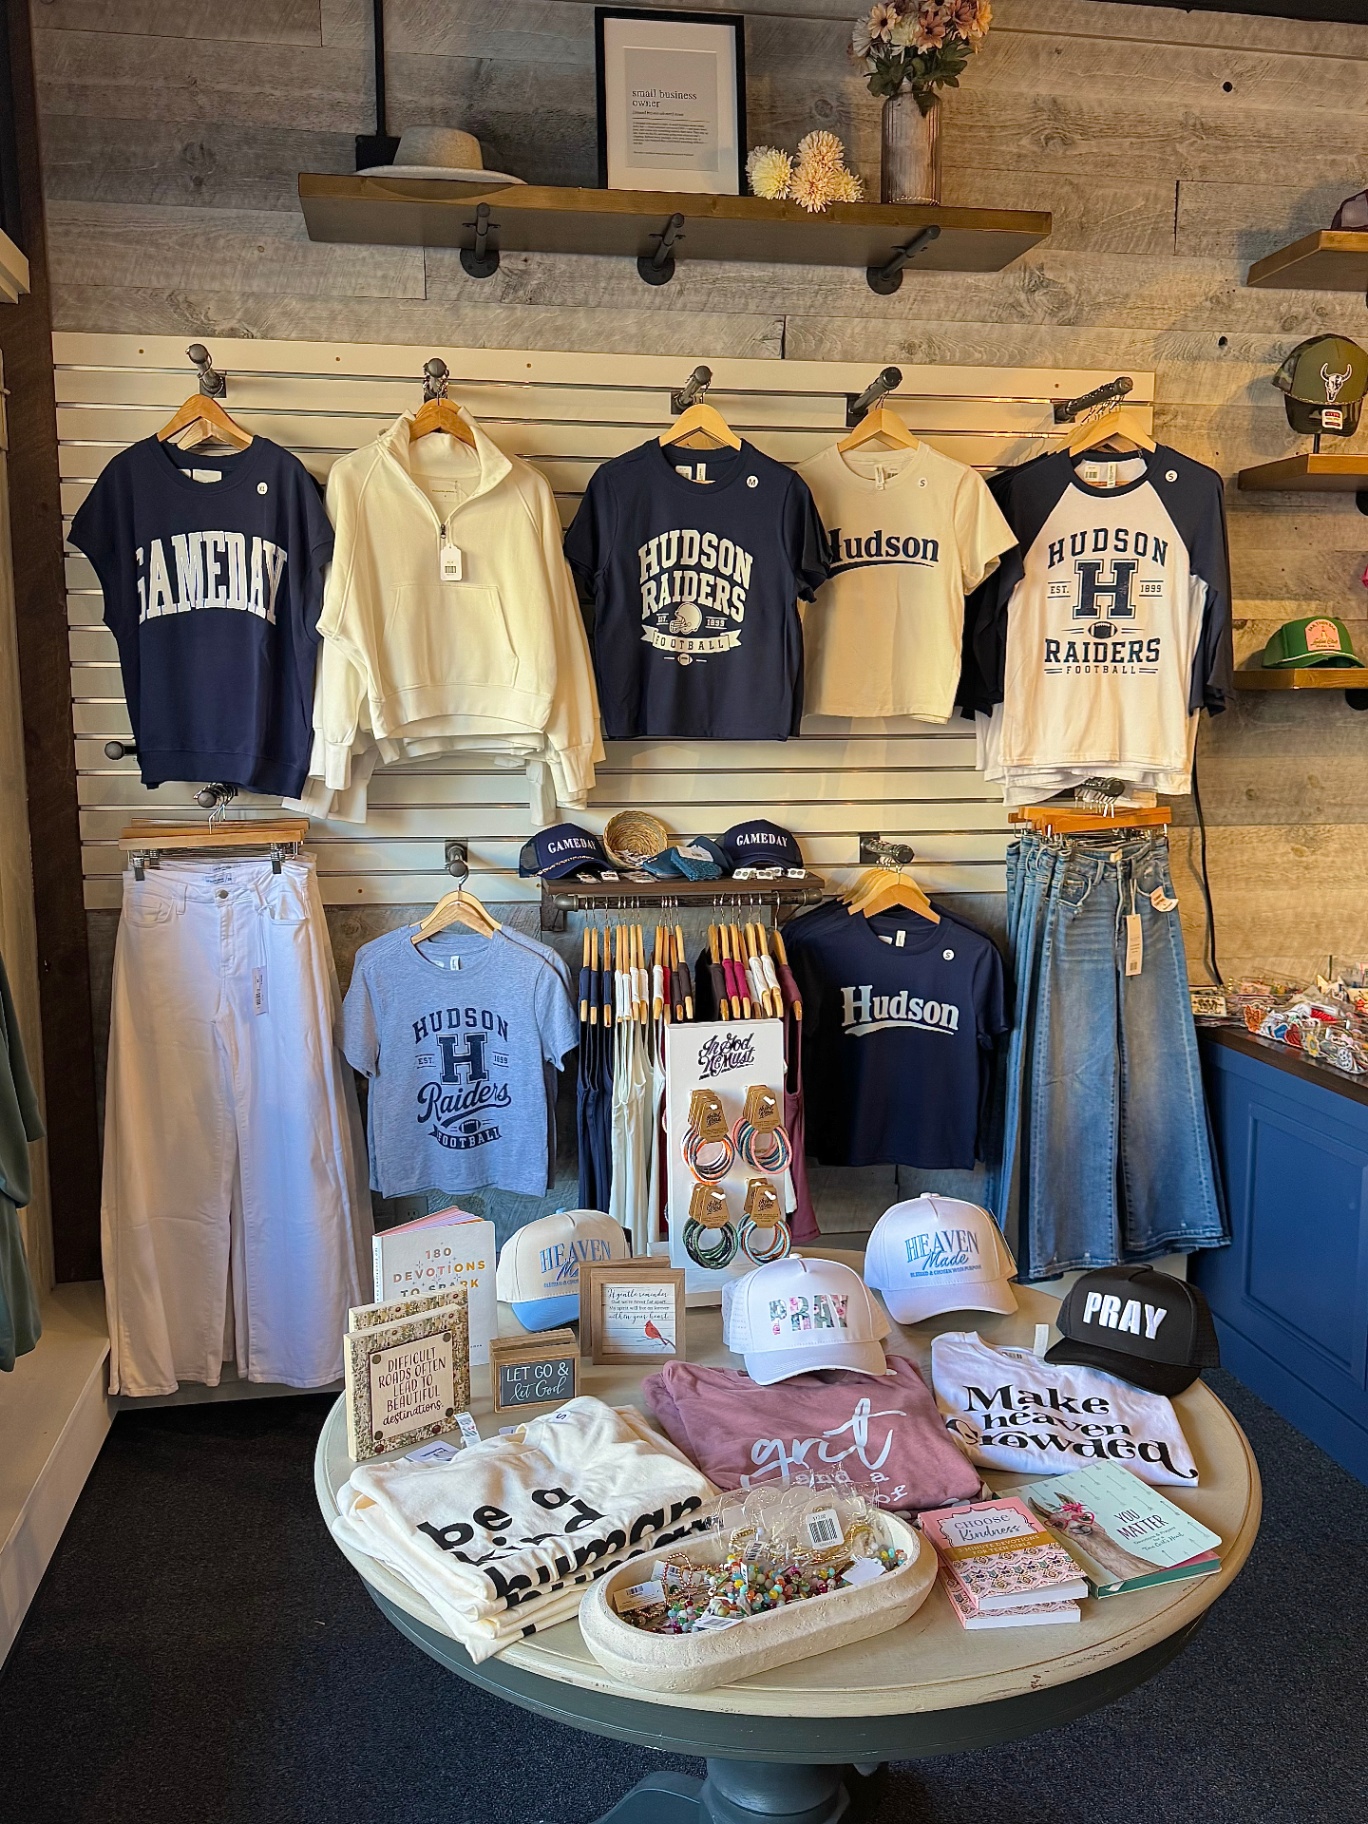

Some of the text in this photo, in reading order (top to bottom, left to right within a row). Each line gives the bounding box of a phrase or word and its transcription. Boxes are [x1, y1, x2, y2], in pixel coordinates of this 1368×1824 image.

[632, 89, 697, 100] small business
[632, 100, 660, 108] owner
[638, 529, 754, 590] HUDSON
[1047, 527, 1169, 570] HUDSON
[640, 570, 747, 623] RAIDERS
[1050, 585, 1070, 594] EST.
[1073, 559, 1139, 619] H
[1140, 584, 1162, 593] 1899
[707, 619, 725, 627] 1899
[655, 635, 724, 651] FOOTBALL
[1044, 637, 1161, 663] RAIDERS
[1066, 665, 1137, 674] FOOTBALL
[547, 840, 597, 854] GAMEDAY
[736, 833, 789, 848] GAMEDAY
[840, 984, 959, 1031] Hudson
[412, 1007, 509, 1044] HUDSON
[702, 1032, 754, 1055] In God
[436, 1032, 490, 1085] H
[417, 1080, 511, 1124] Raiders
[436, 1126, 500, 1149] FOOTBALL
[425, 1247, 452, 1260] 180
[539, 1239, 611, 1273] HEAVEN
[905, 1230, 980, 1263] HEAVEN
[393, 1260, 486, 1283] DEVOTIONS
[556, 1258, 579, 1281] Ma
[922, 1249, 969, 1270] Made
[768, 1294, 849, 1336] PRAY
[1082, 1291, 1168, 1340] PRAY
[388, 1346, 436, 1373] DIFFICULT
[506, 1361, 569, 1382] LET GO &
[378, 1356, 446, 1389] ROADS OFTEN
[393, 1374, 433, 1398] LEAD TO
[510, 1377, 567, 1401] let God
[387, 1385, 440, 1413] BEAUTIFUL
[962, 1384, 1110, 1415] Make
[383, 1400, 444, 1426] destinations.
[982, 1410, 1134, 1438] heaven
[740, 1398, 907, 1488] grit
[869, 1471, 890, 1483] a
[416, 1487, 576, 1550] be a
[954, 1514, 1010, 1530] CHOOSE
[1113, 1508, 1140, 1523] YOU
[1116, 1514, 1169, 1541] MATTER
[958, 1524, 1021, 1542] Kindness
[995, 1535, 1040, 1546] DEVOTIONS
[1010, 1541, 1032, 1549] GIRLS
